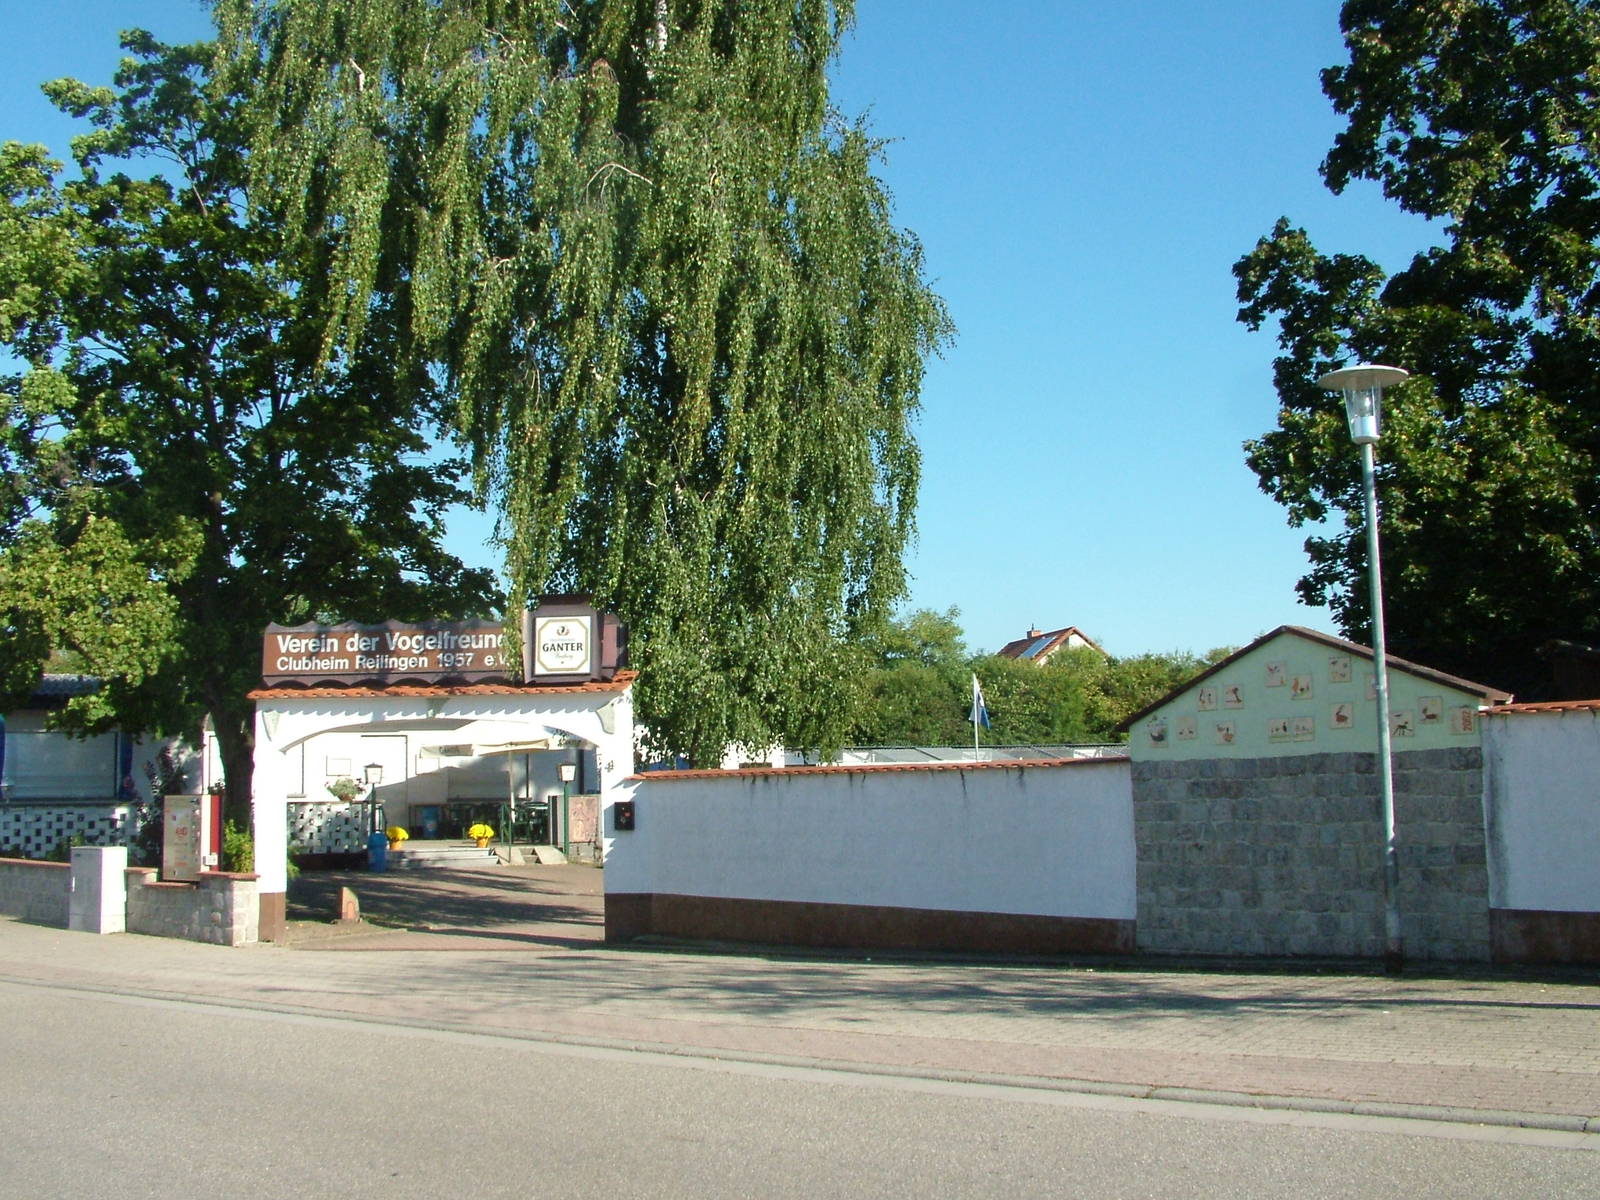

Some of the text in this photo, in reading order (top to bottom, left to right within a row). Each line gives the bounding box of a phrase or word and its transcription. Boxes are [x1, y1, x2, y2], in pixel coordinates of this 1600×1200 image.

[277, 634, 339, 654] Verein
[345, 632, 380, 652] der
[542, 642, 583, 652] GANTER
[276, 655, 349, 670] Clubheim
[355, 654, 428, 671] Reilingen
[437, 652, 474, 667] 1957
